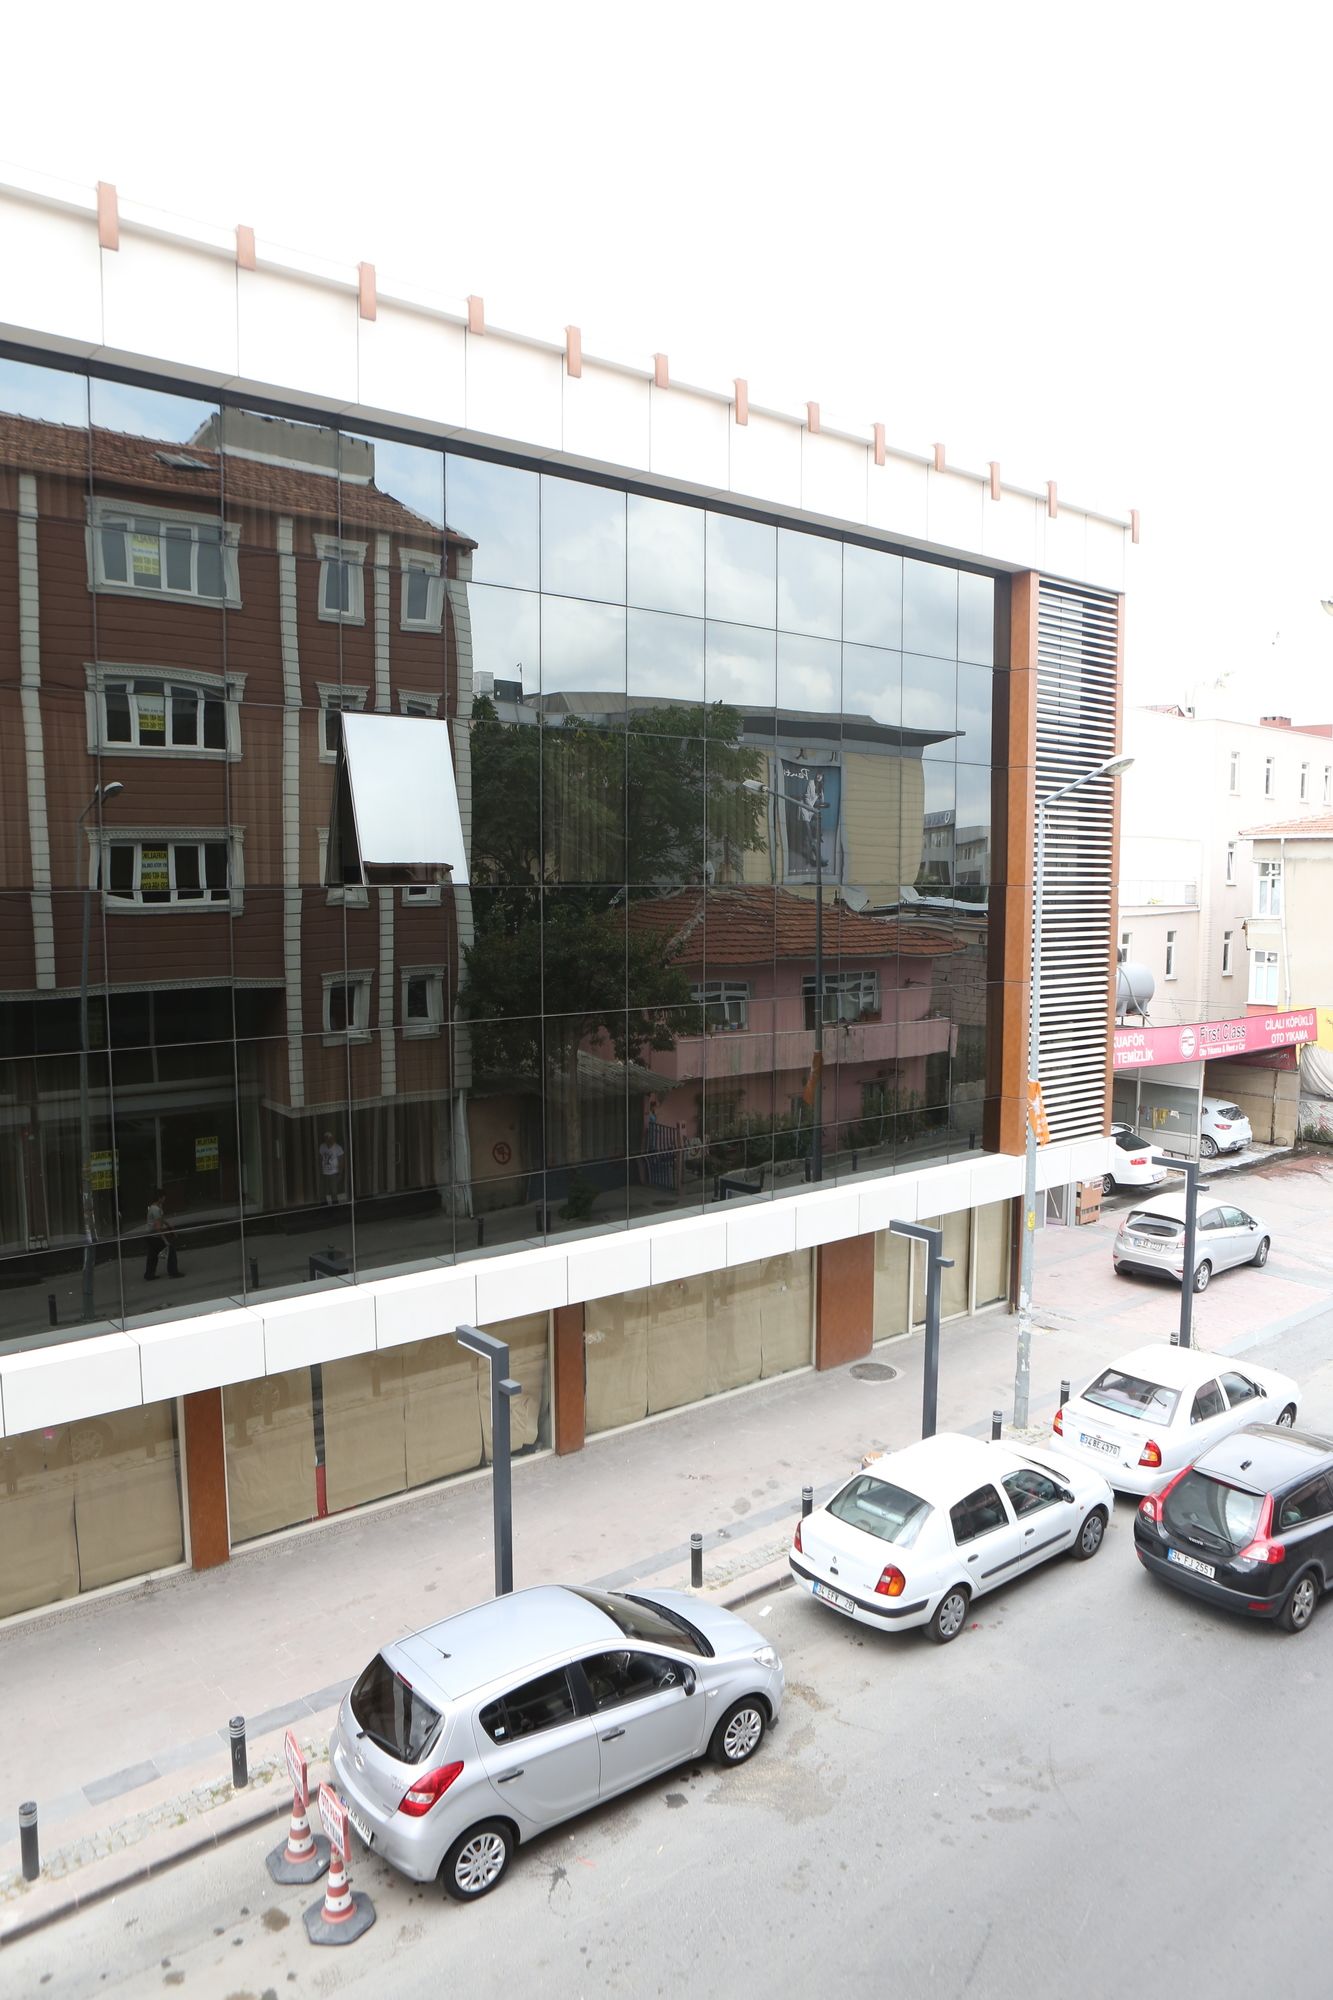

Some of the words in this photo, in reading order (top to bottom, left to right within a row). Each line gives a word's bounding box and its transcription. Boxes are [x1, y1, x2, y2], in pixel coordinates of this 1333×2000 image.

[1200, 1025, 1220, 1042] First
[1222, 1023, 1246, 1040] Class
[1271, 1032, 1285, 1044] OTO
[1285, 1030, 1309, 1042] YIKAMA
[1117, 1048, 1154, 1065] TEMİZLİK
